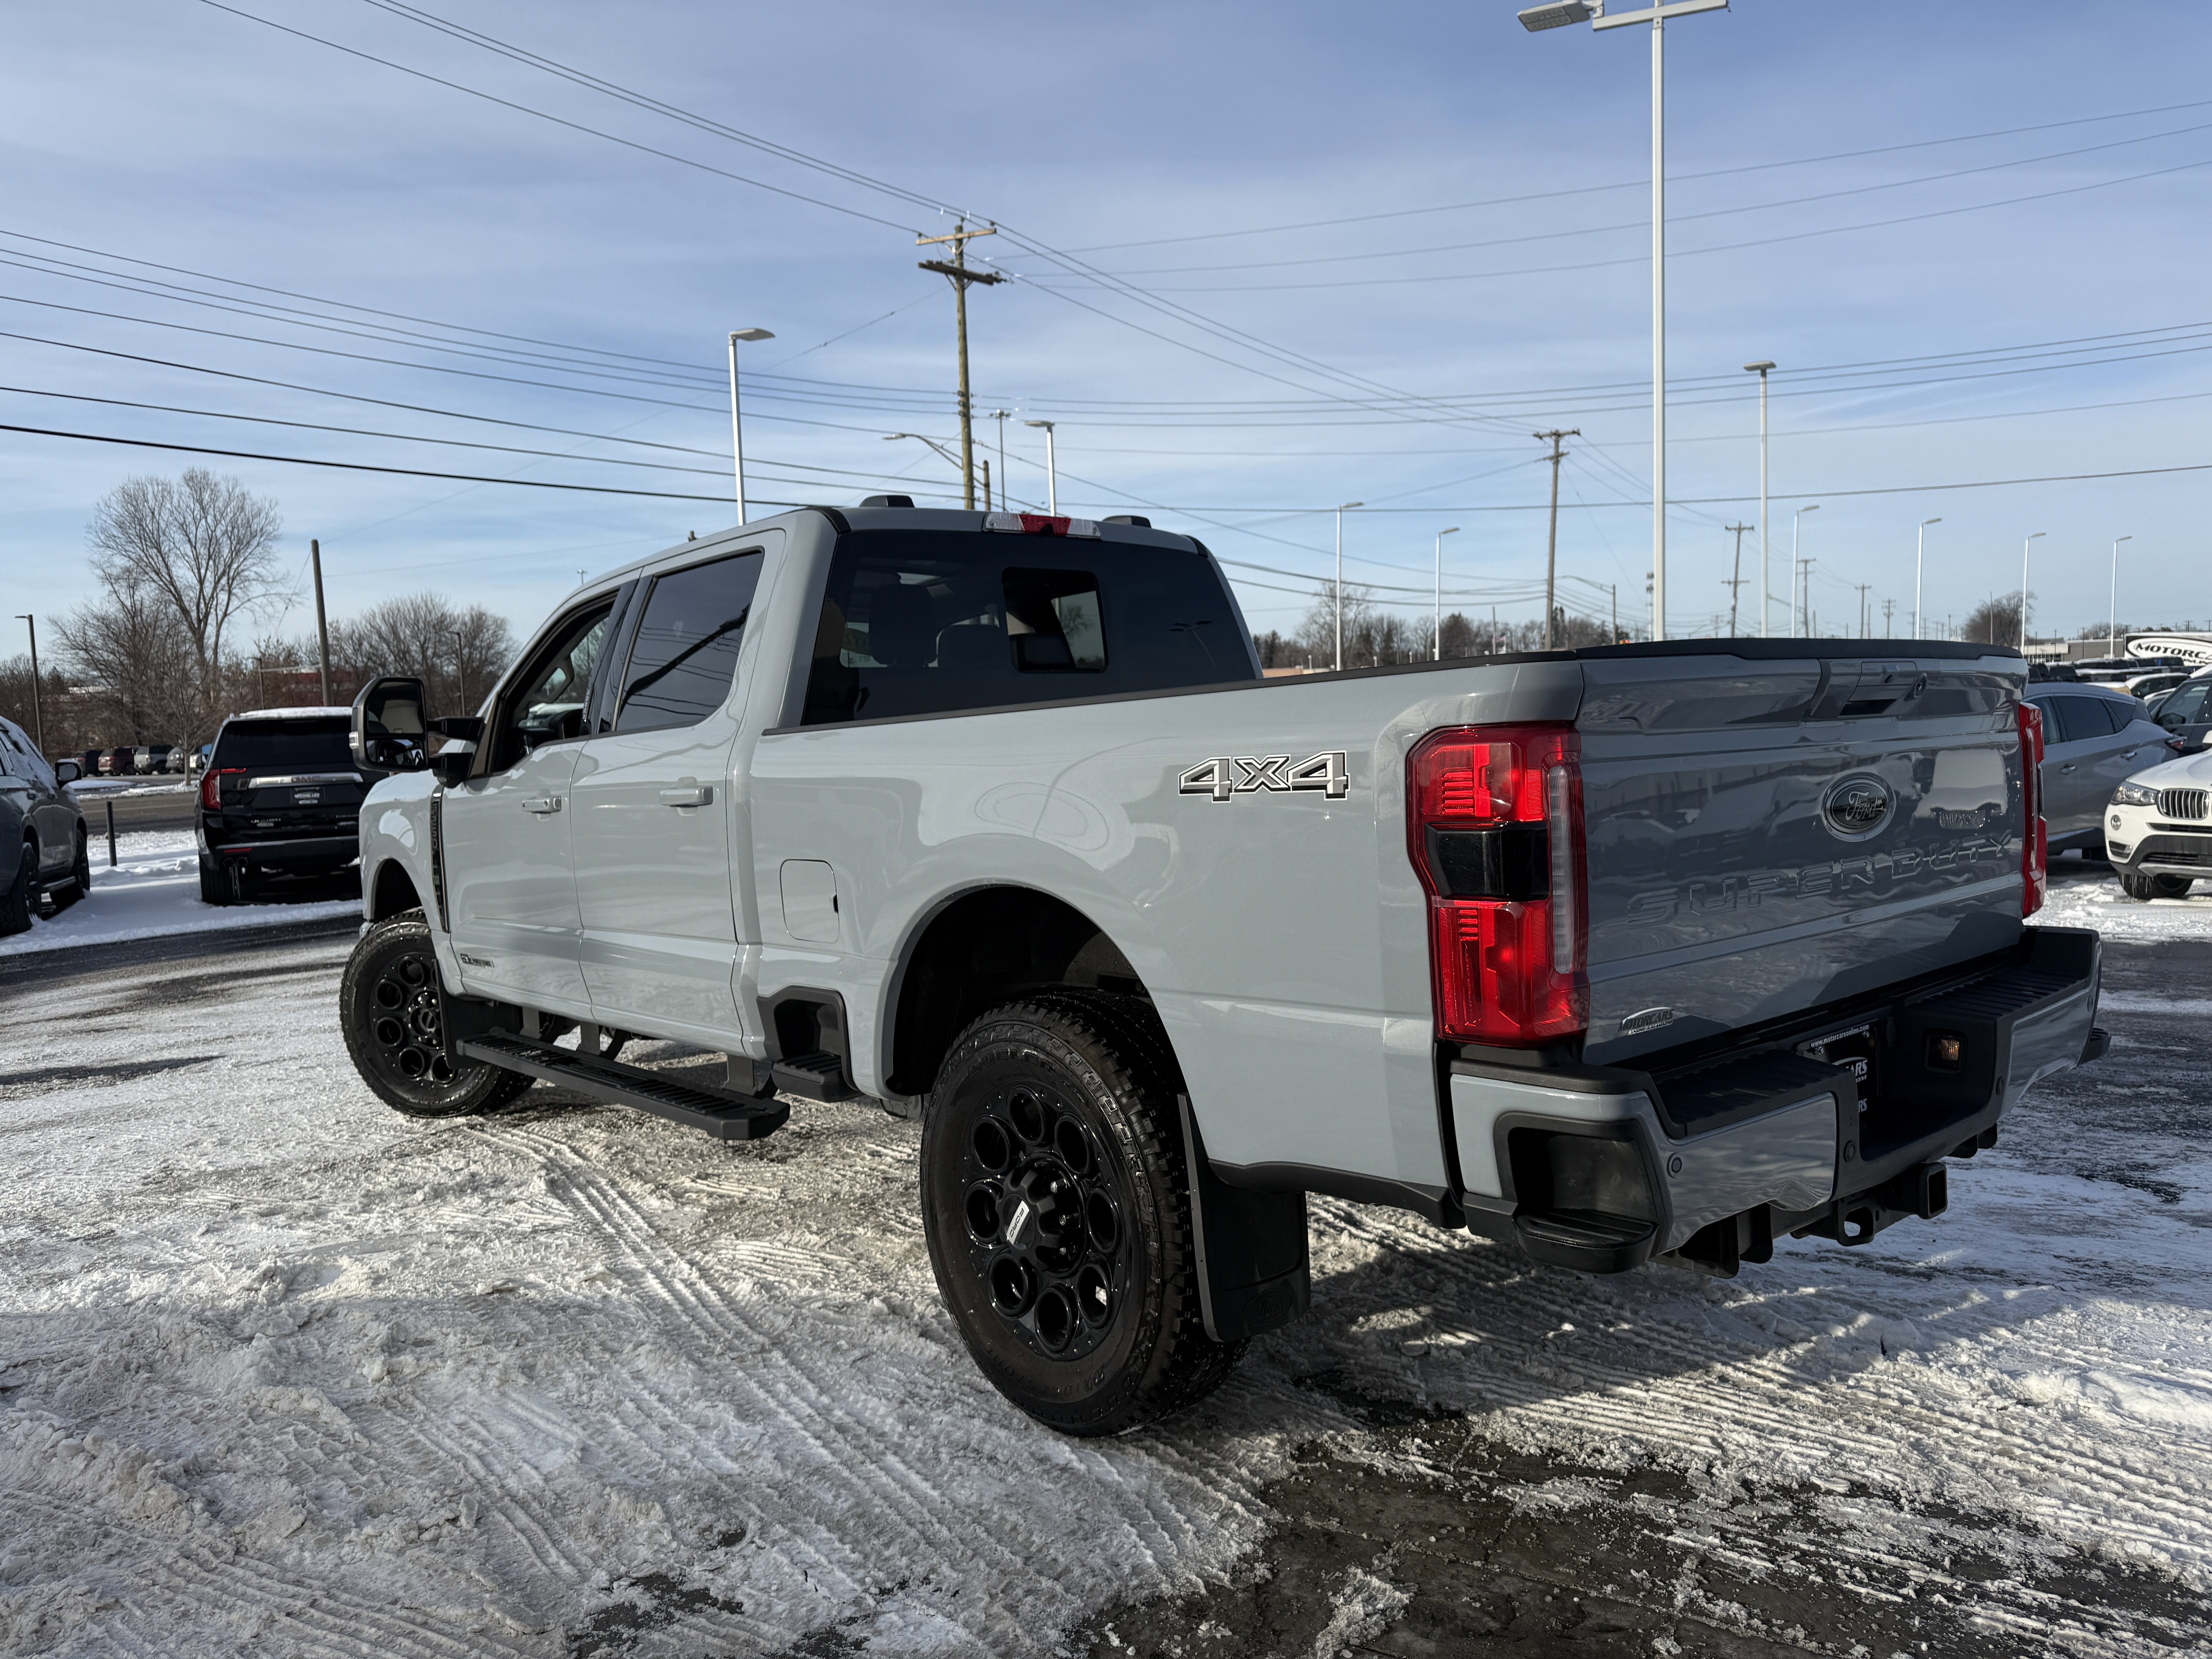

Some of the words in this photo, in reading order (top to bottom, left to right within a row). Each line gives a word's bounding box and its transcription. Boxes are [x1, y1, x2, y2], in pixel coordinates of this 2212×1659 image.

[1846, 791, 1885, 821] Ford
[1628, 855, 1875, 927] SUPER
[1892, 830, 2012, 879] DUTY
[1618, 1009, 1674, 1032] MOTORCARS
[1810, 1024, 1870, 1048] www.motorcarsonline.com
[1010, 1207, 1024, 1238] FORD
